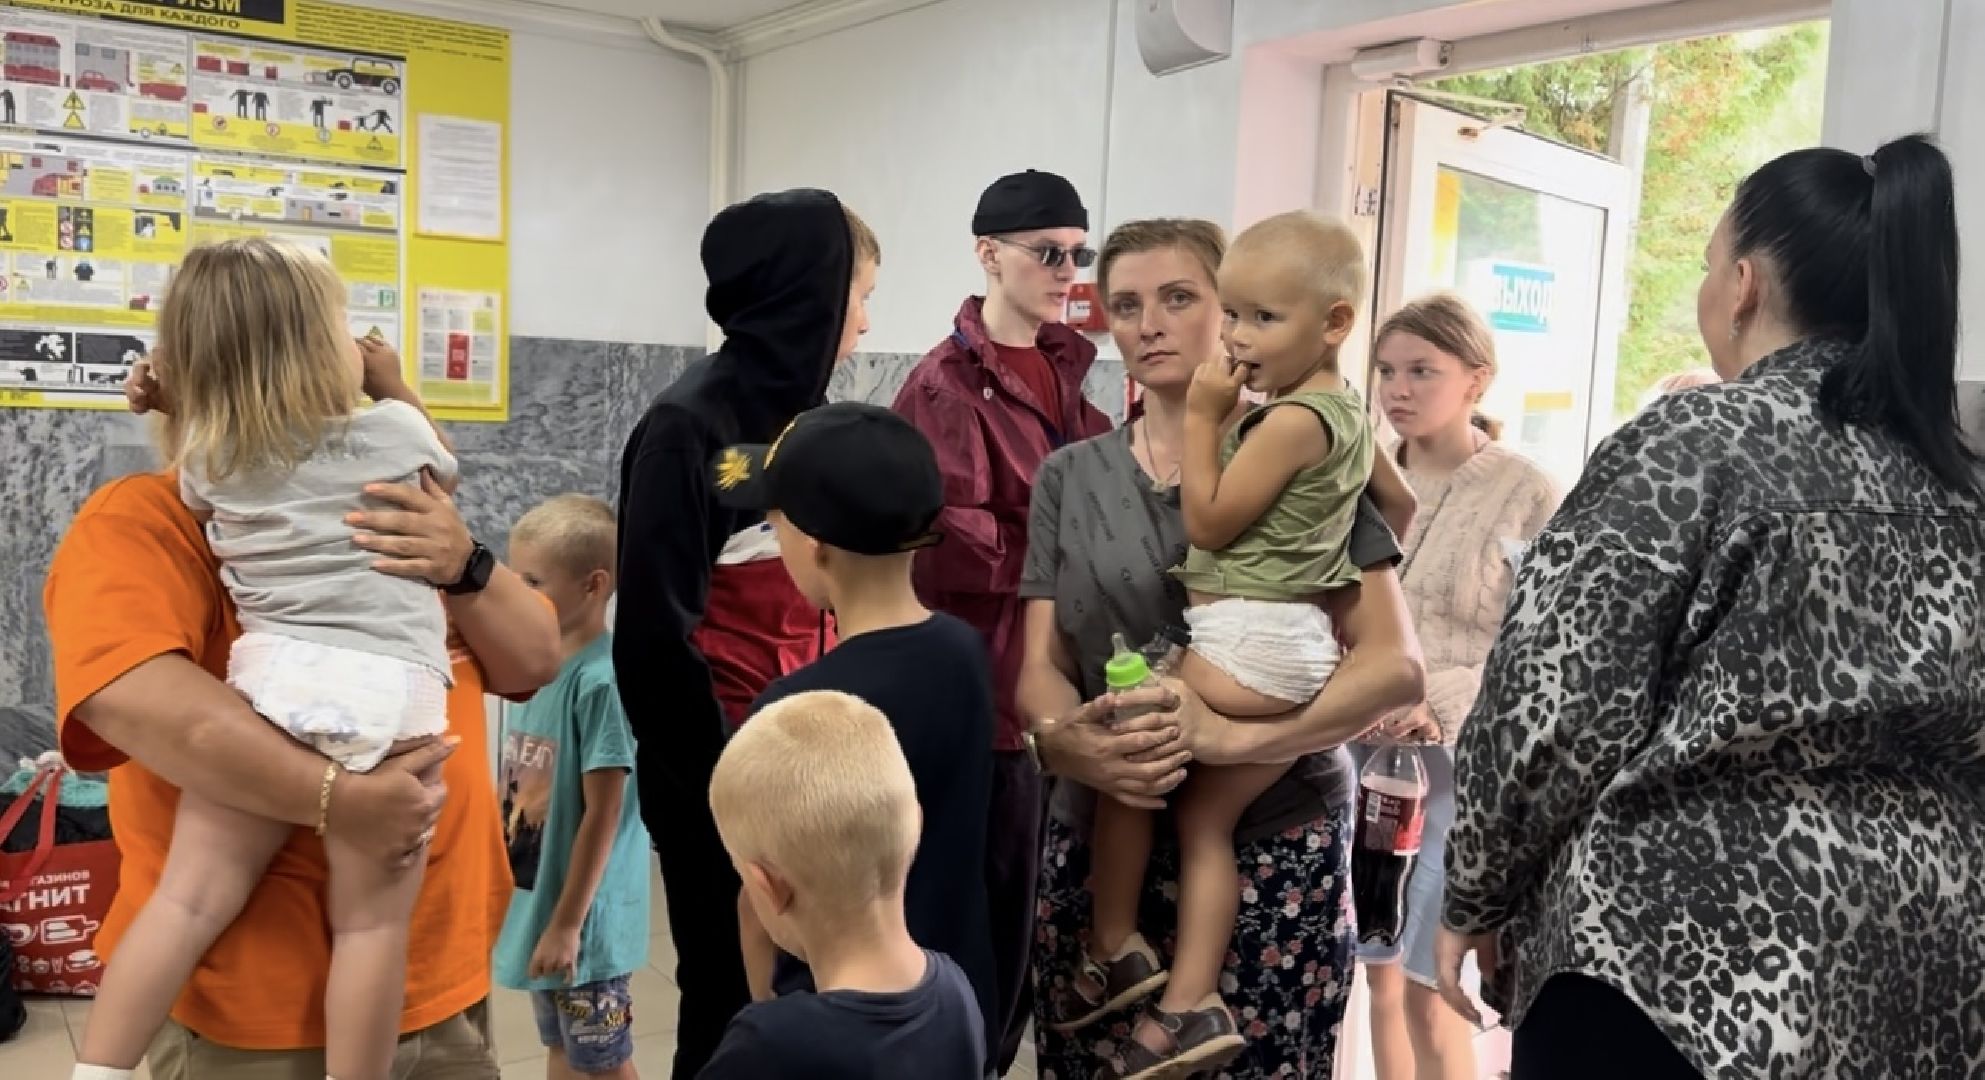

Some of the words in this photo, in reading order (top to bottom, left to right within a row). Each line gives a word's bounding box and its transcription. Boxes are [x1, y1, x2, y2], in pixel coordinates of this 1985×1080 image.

[120, 3, 155, 16] ДЛЯ
[160, 9, 241, 29] КАЖДОГО
[31, 870, 90, 885] ГАЗИНОВ
[0, 883, 90, 912] ГНИТ
